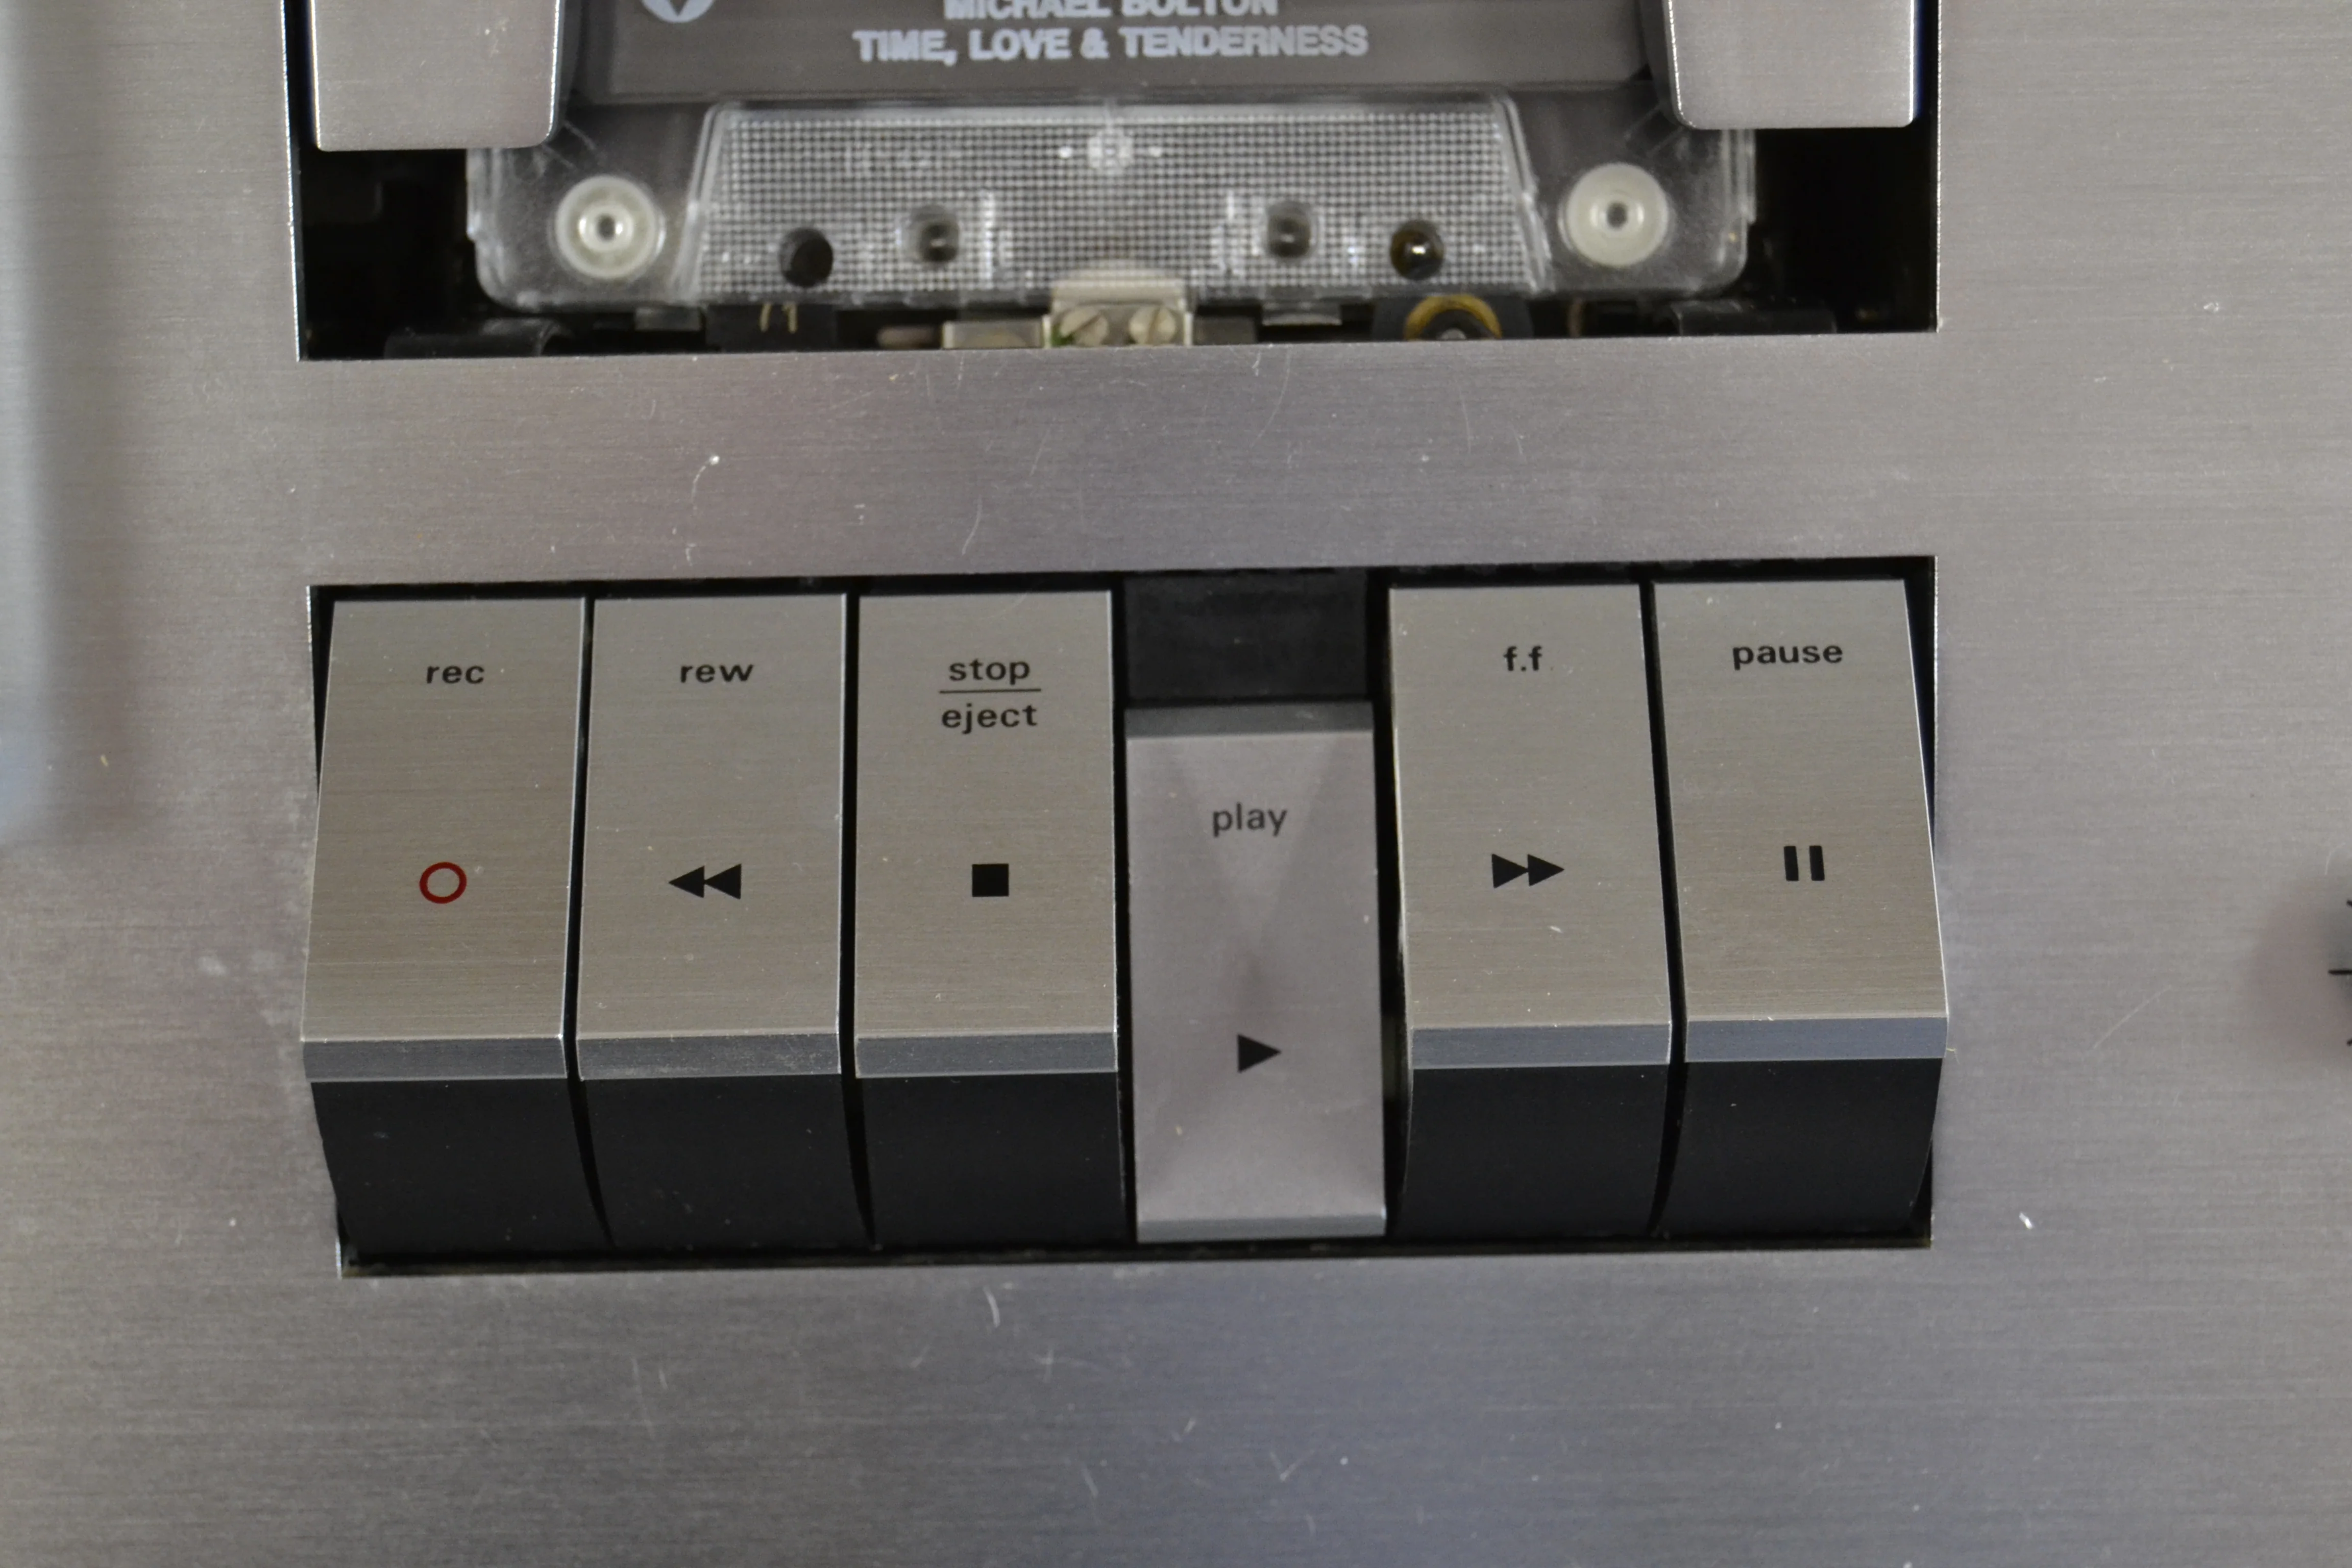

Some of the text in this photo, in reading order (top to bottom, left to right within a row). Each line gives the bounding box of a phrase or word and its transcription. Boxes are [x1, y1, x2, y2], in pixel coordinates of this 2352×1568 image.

[852, 25, 1369, 66] TIME, LOVE & TENDERNESS
[948, 658, 1031, 685] stop
[1503, 645, 1542, 672] f.f
[1732, 645, 1844, 671] pause
[426, 665, 485, 685] rec
[679, 664, 754, 684] rew
[941, 702, 1038, 736] eject
[1211, 802, 1288, 839] play
